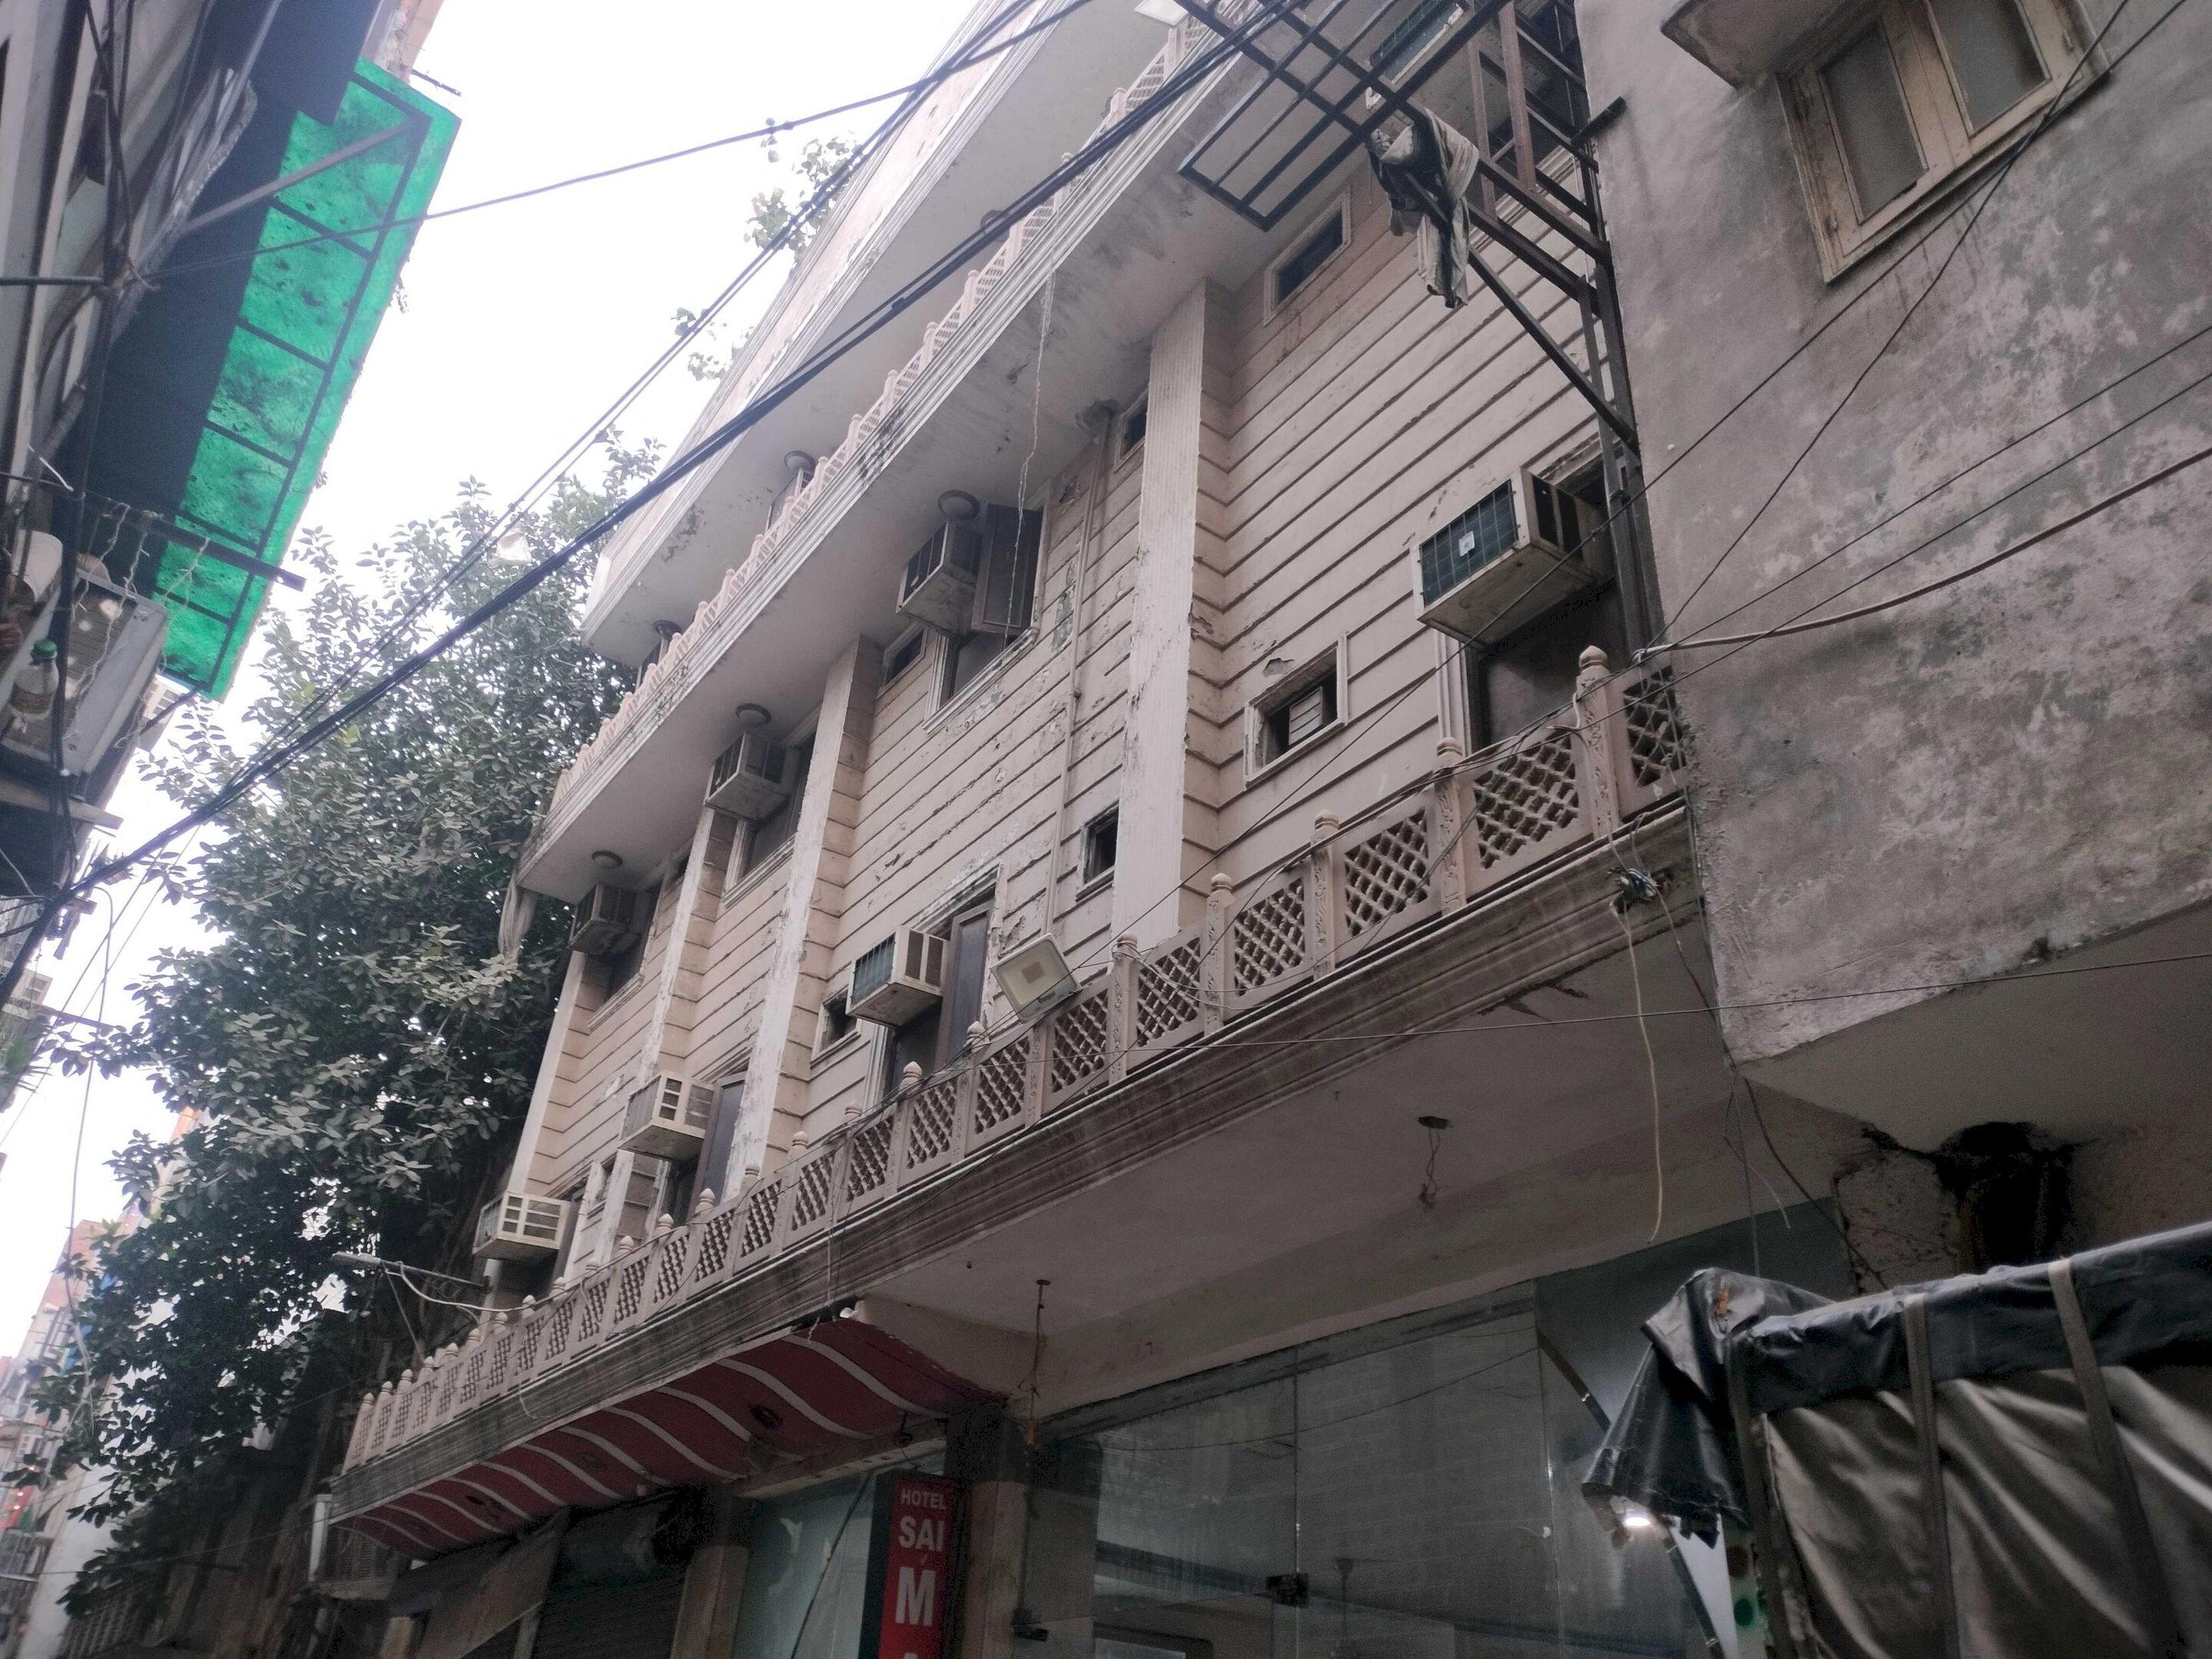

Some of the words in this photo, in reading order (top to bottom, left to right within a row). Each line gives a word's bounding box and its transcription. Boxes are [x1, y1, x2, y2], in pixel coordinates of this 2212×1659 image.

[901, 1488, 945, 1509] HOTEL
[899, 1515, 944, 1552] SAI
[896, 1566, 936, 1659] M
